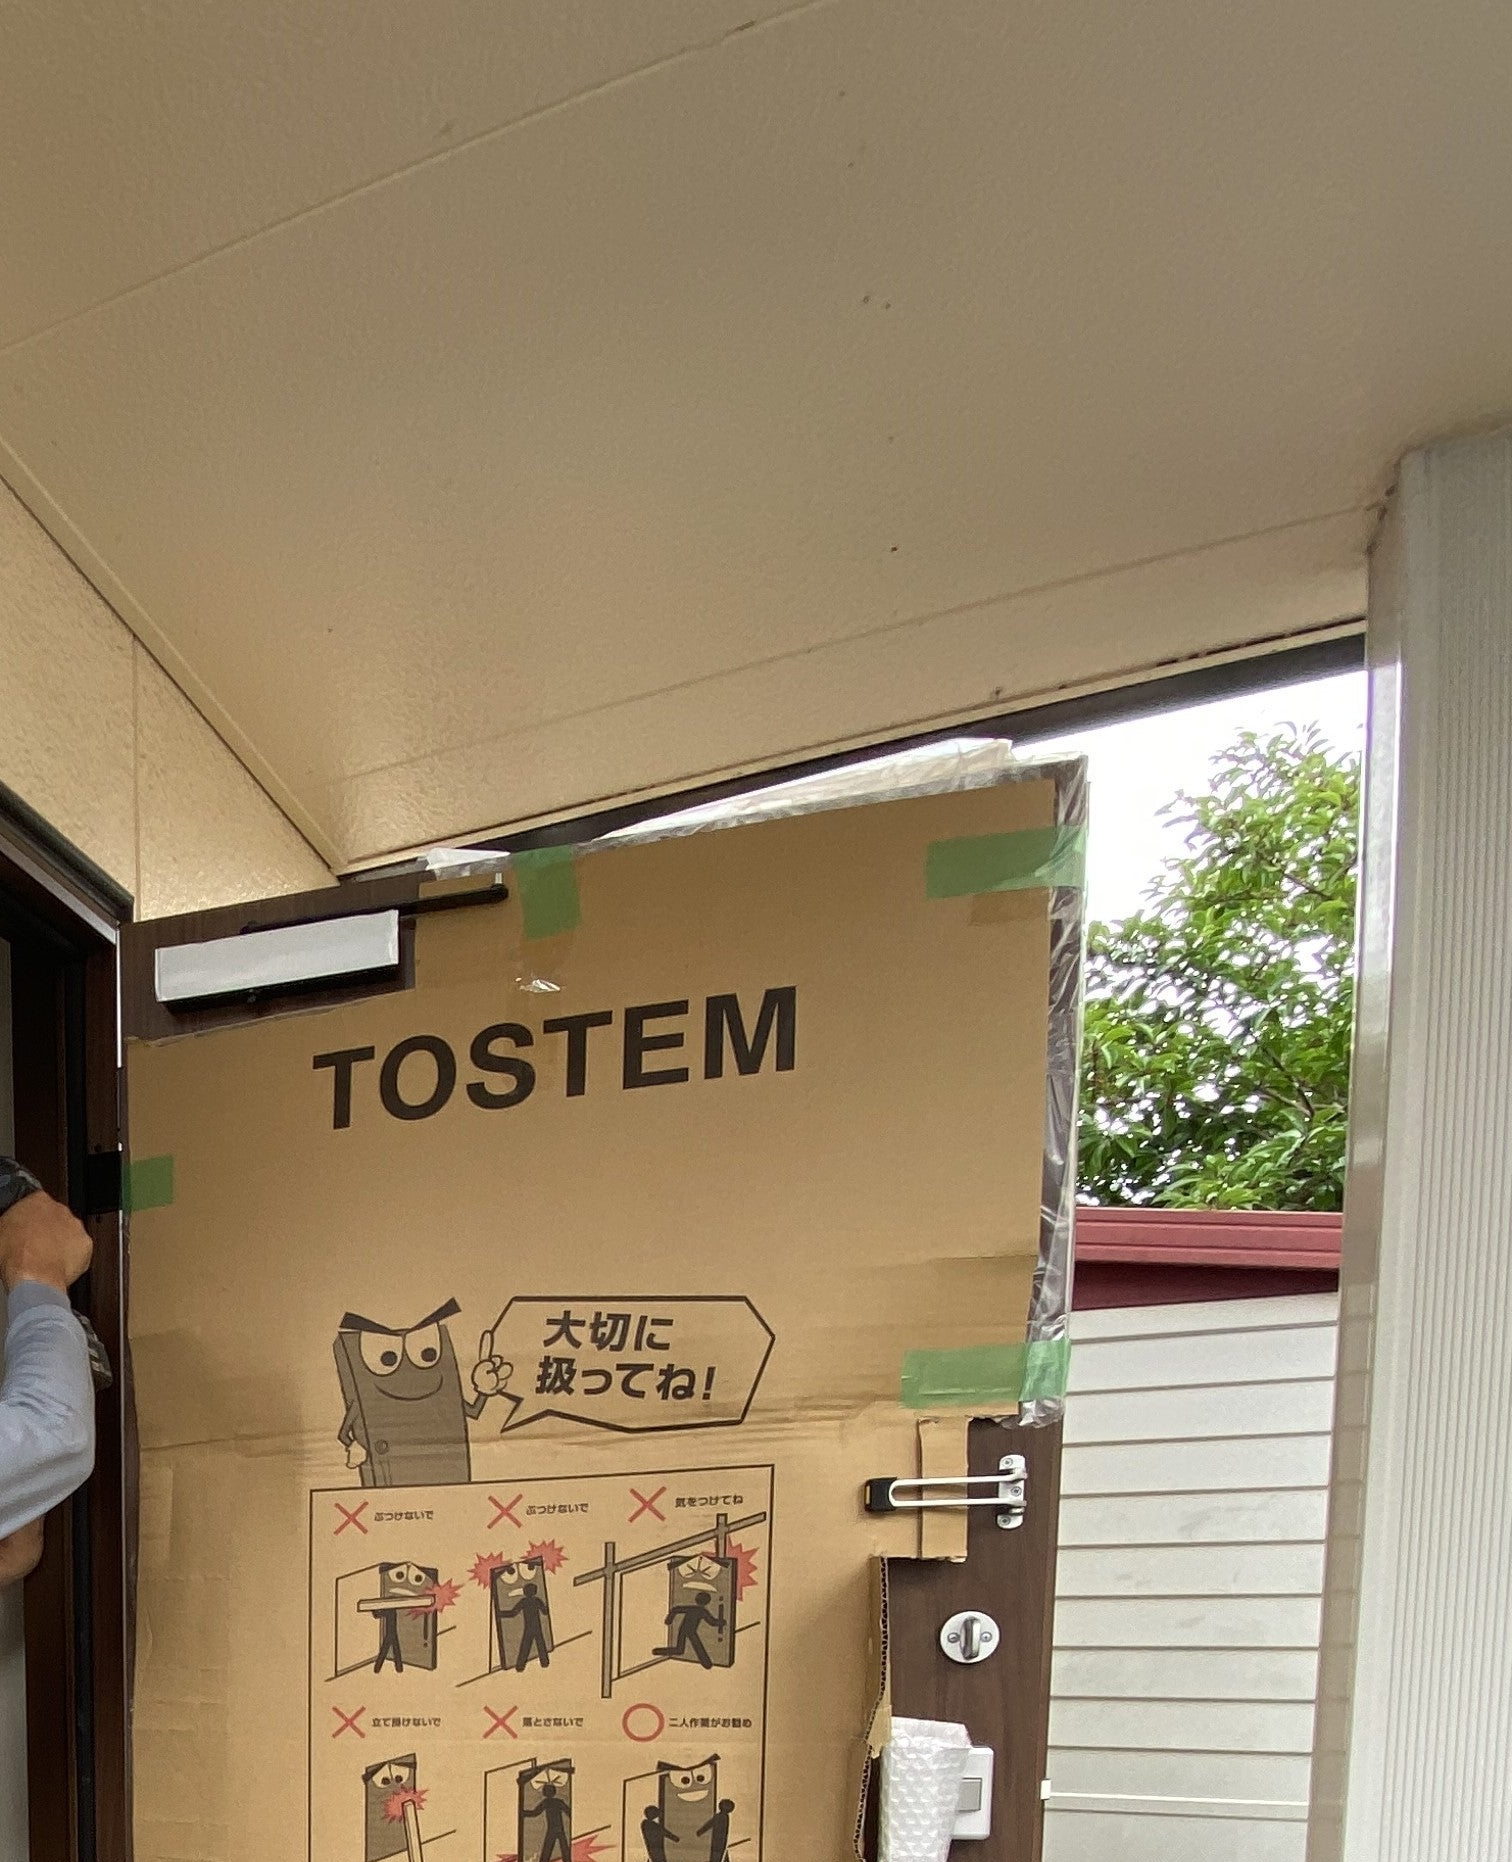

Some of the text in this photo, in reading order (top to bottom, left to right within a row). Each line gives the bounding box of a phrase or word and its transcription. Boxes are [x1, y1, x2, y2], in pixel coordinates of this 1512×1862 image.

[313, 986, 797, 1130] TOSTEM
[543, 1311, 674, 1352] 大切に
[675, 1495, 744, 1508] 気をつけてね
[374, 1510, 434, 1522] ぶつけないで
[526, 1503, 589, 1516] ぶつけないで
